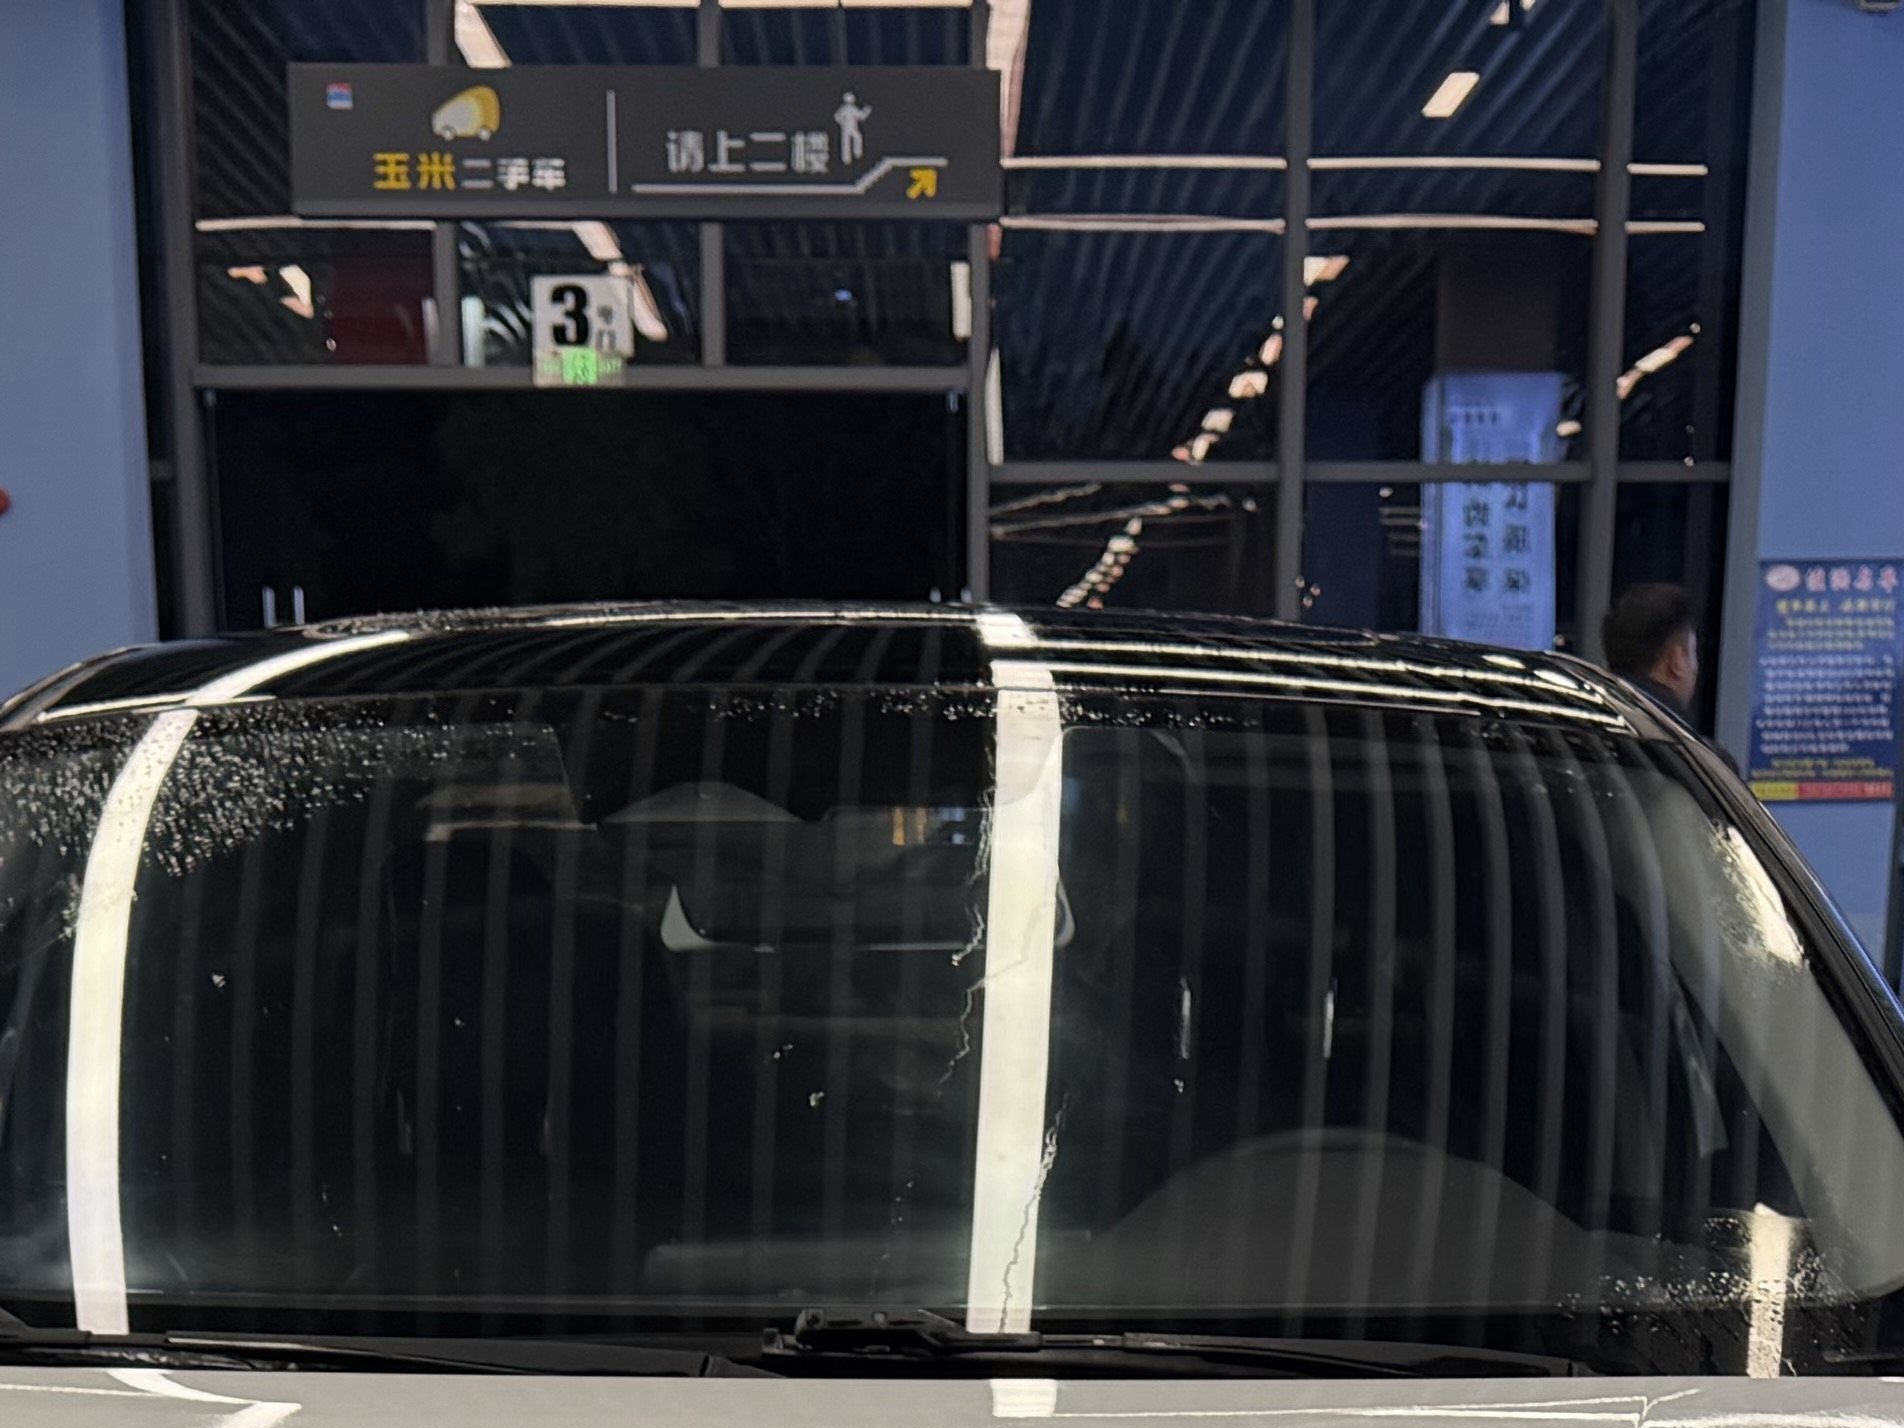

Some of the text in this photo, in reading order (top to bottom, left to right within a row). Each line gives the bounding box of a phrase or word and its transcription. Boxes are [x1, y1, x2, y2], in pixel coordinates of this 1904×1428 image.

[373, 152, 566, 190] 玉米二手车
[665, 129, 829, 174] 请上二楼
